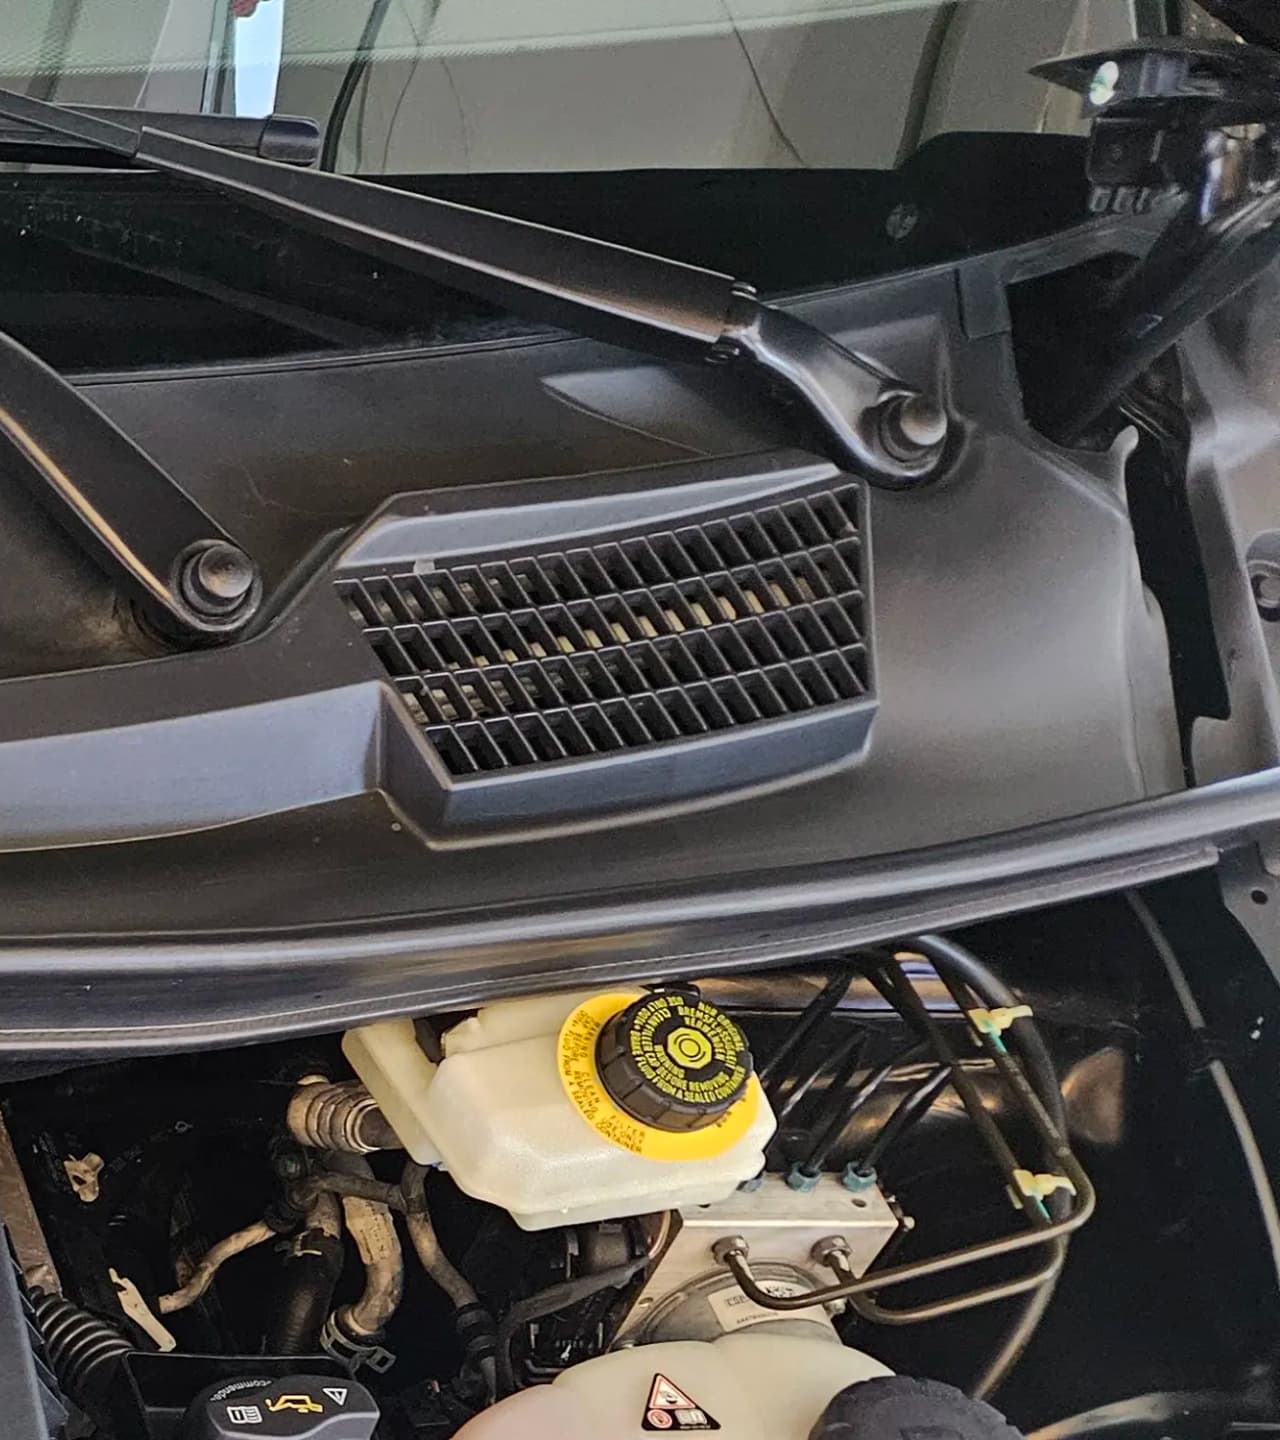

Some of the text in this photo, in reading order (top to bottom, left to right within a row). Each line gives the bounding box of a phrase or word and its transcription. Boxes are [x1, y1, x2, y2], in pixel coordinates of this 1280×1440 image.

[644, 1052, 661, 1067] CAP
[635, 1056, 656, 1079] FLUID
[684, 1091, 717, 1103] SEALED
[595, 1121, 643, 1154] CONTAINER
